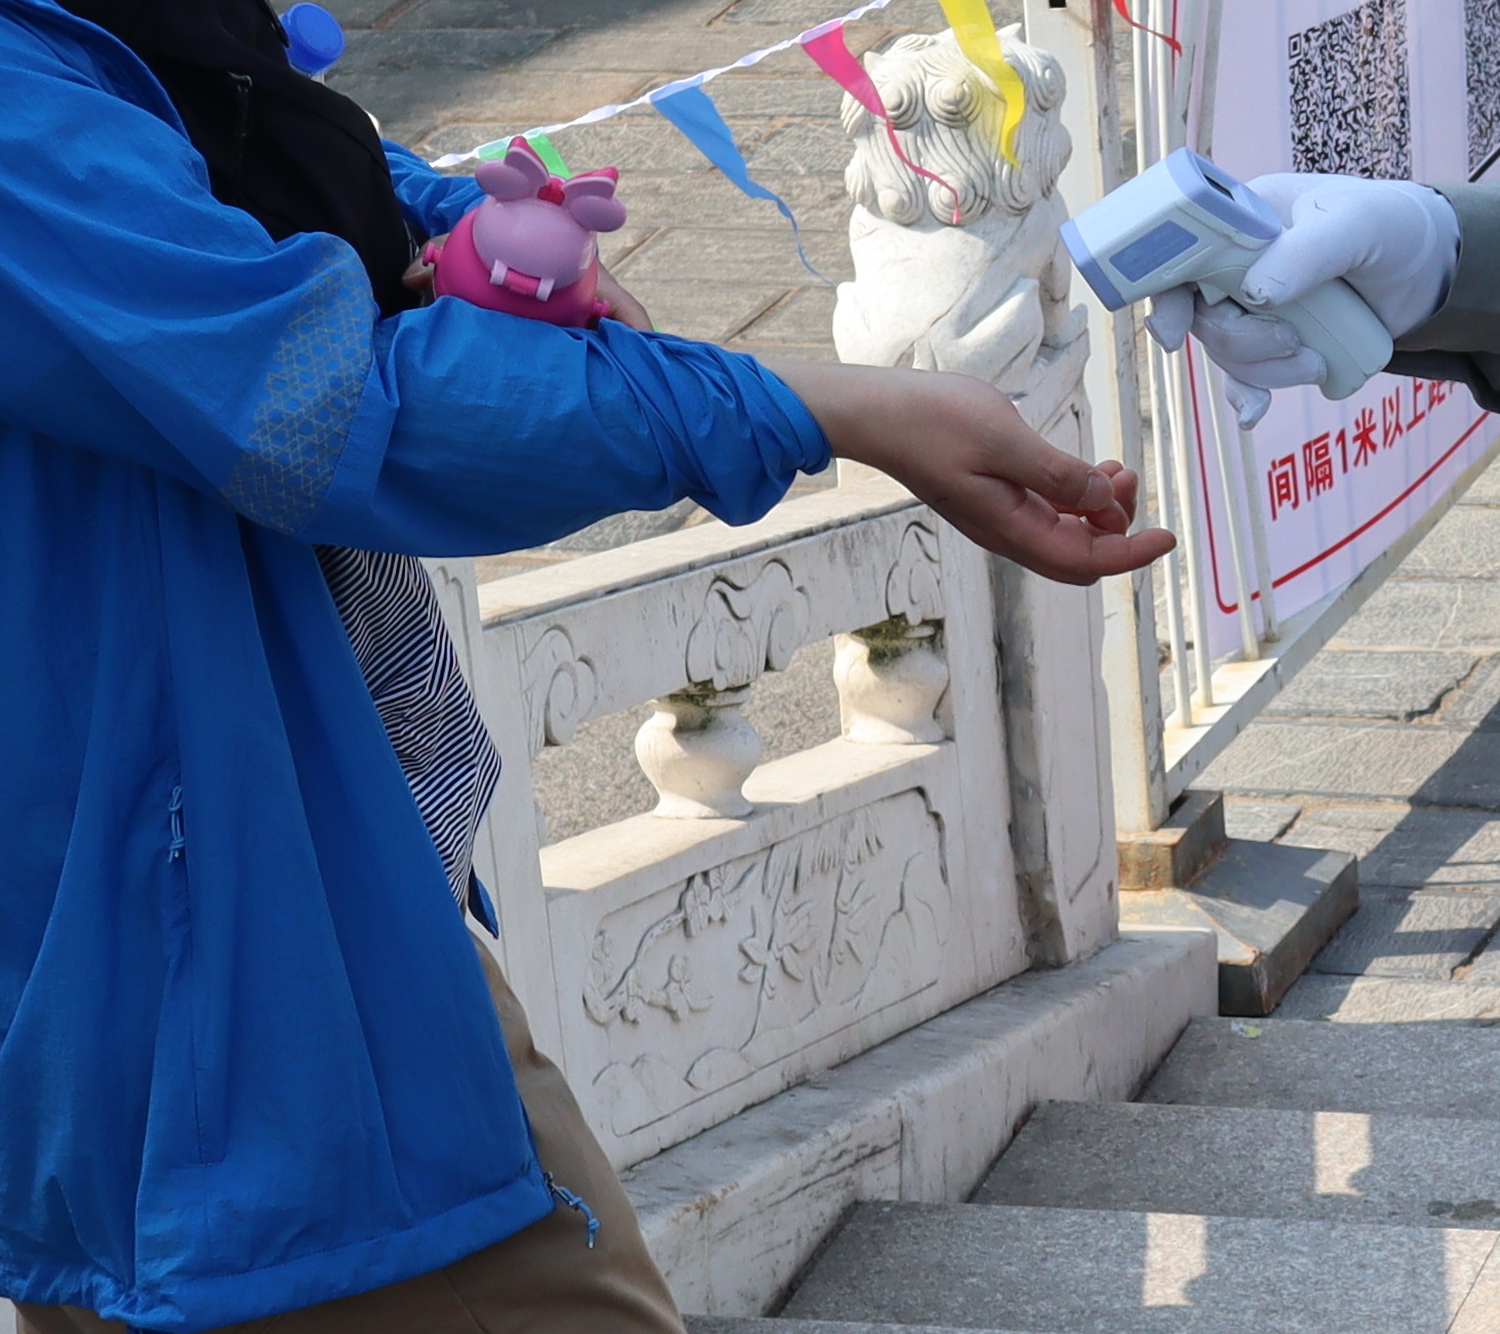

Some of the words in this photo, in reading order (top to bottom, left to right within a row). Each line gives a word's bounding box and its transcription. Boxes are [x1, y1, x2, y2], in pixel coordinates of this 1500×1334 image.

[1267, 376, 1457, 521] 间隔1米以上
